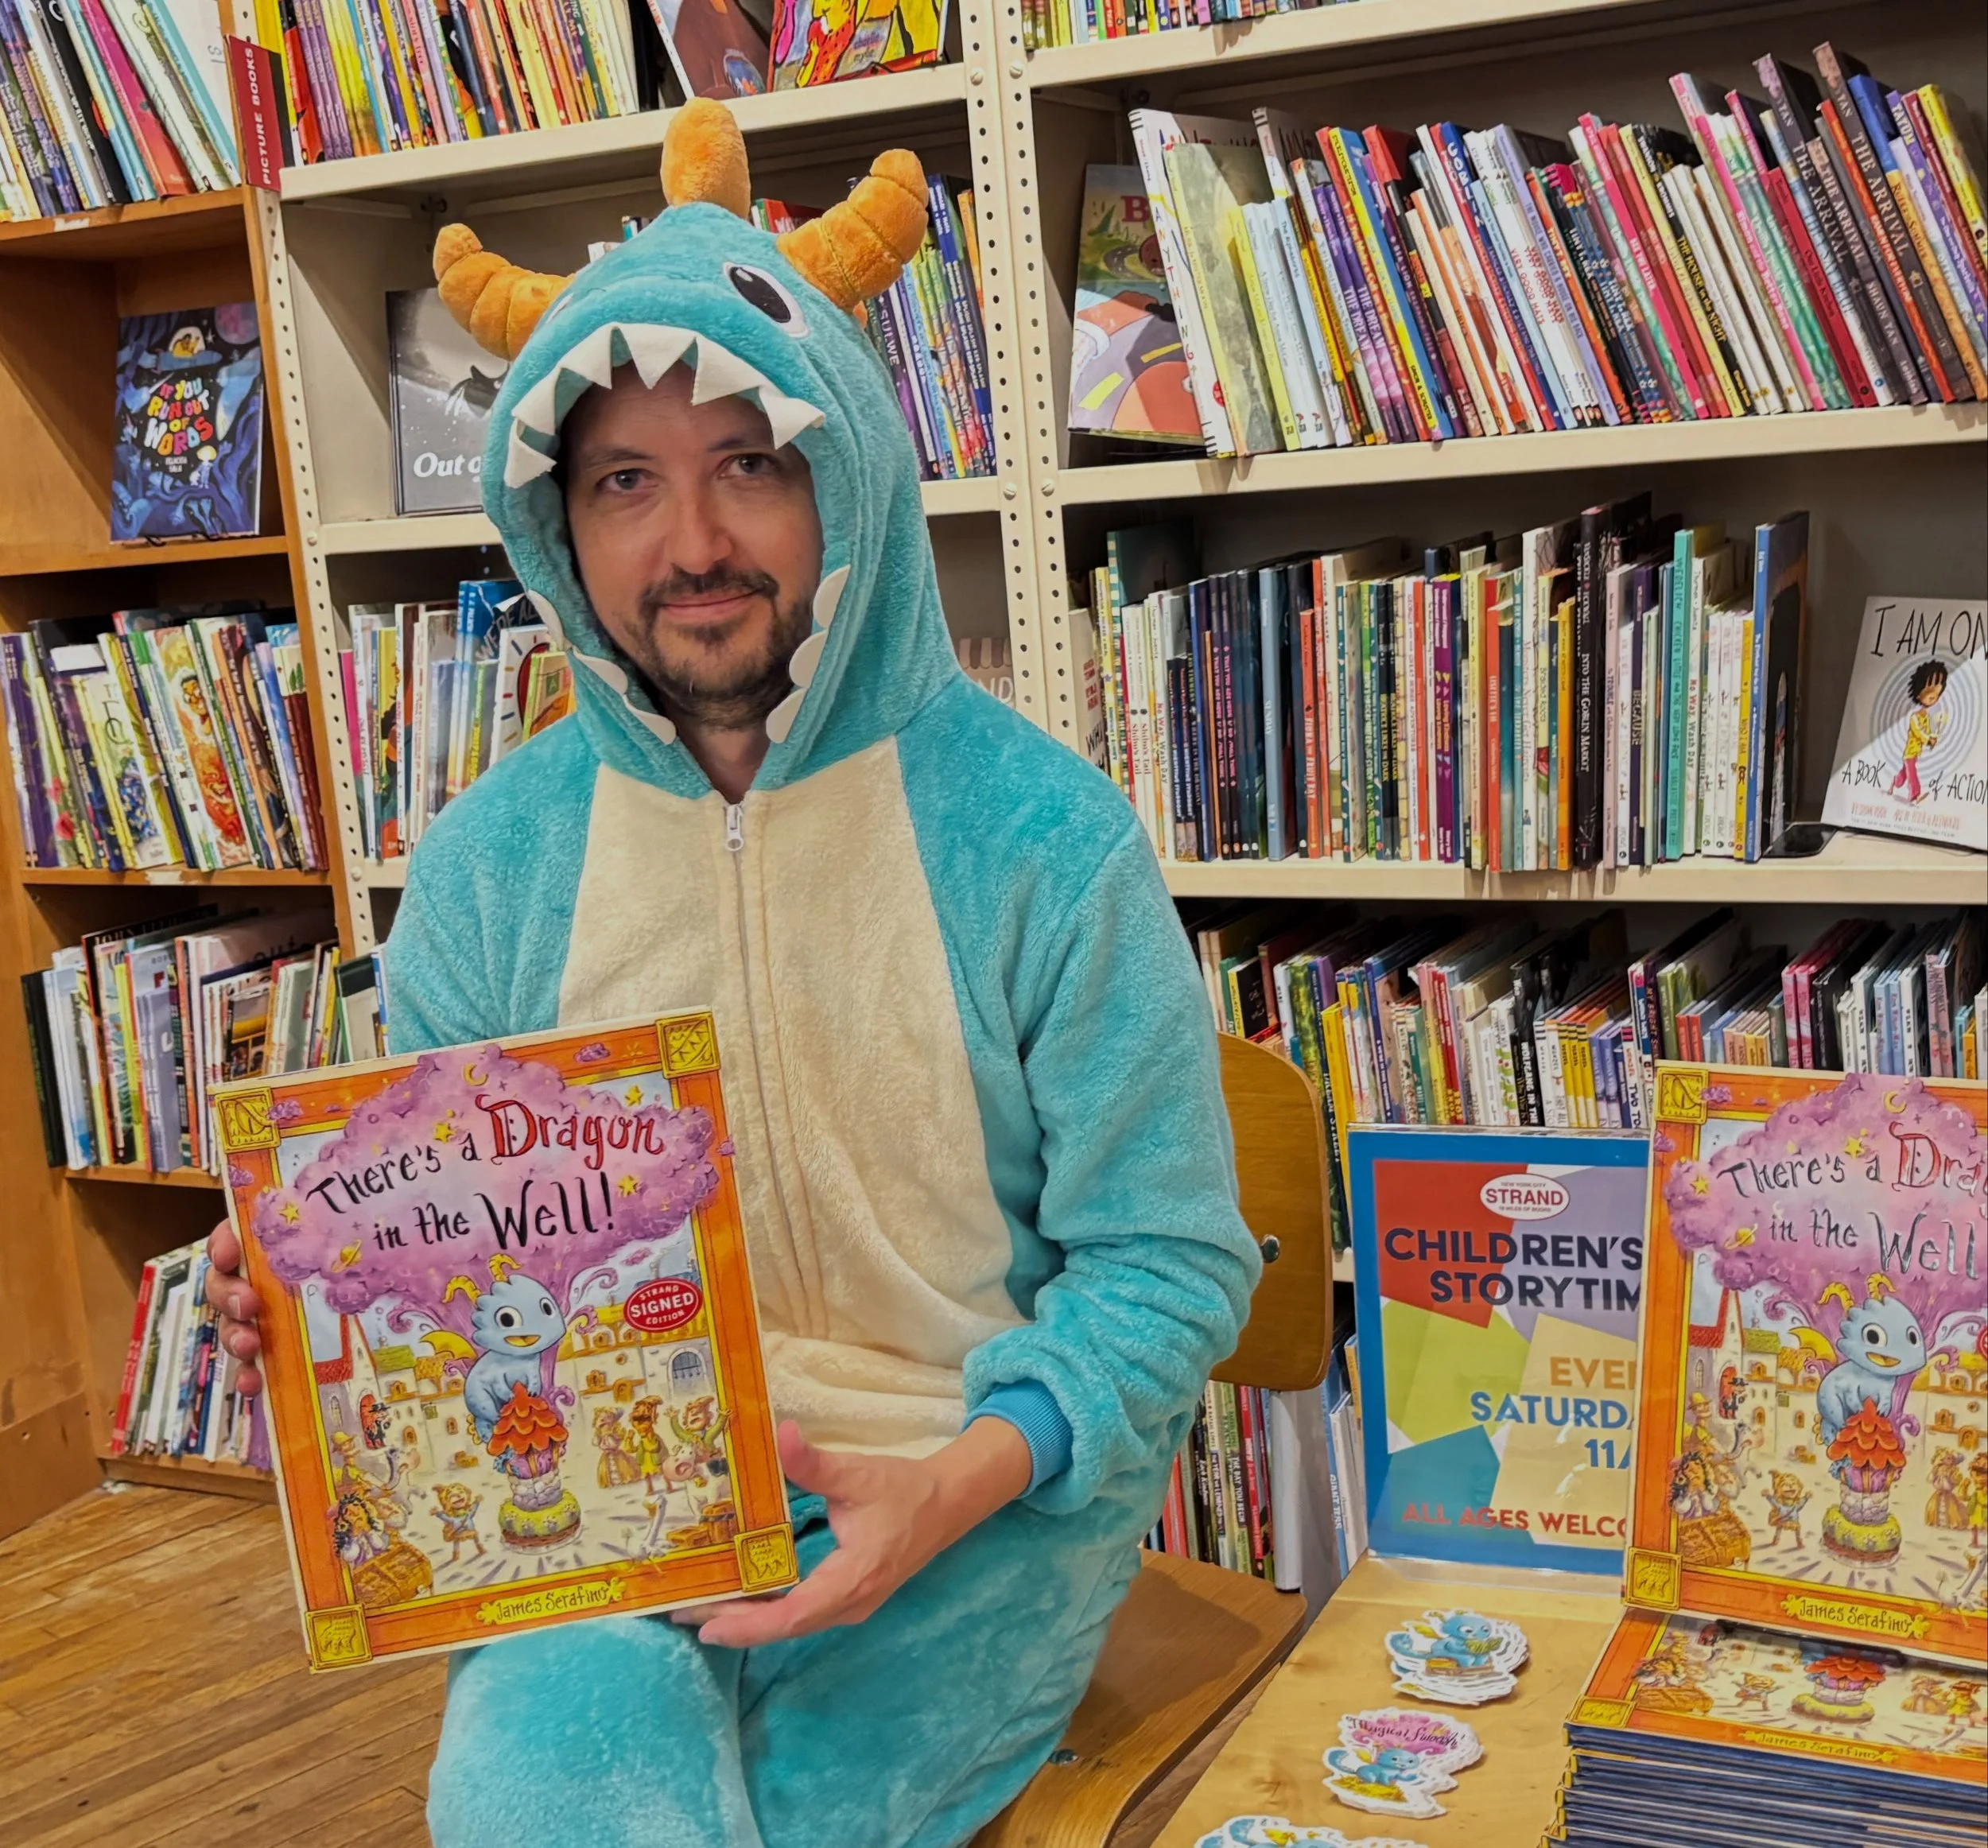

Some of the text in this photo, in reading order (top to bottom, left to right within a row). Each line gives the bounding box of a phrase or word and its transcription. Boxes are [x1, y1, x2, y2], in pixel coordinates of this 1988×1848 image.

[245, 48, 271, 184] PICTURE BOOKS
[1777, 103, 1794, 127] TAN
[1836, 92, 1854, 118] TAN
[1445, 141, 1485, 227] GOBLIN
[1637, 135, 1675, 218] SWANSON KROMMES
[1850, 131, 1911, 257] THE ARRIVAL
[1792, 142, 1848, 263] THE ARRIVAL
[1819, 166, 1866, 262] THE ARRIVAL
[1524, 202, 1535, 214] THE
[1537, 236, 1549, 250] WHO
[1546, 227, 1560, 250] TINY
[1568, 227, 1583, 251] TINY
[1581, 259, 1594, 280] REX
[1735, 210, 1755, 243] Simon
[1760, 270, 1780, 305] Better
[1773, 305, 1790, 330] Bone
[1508, 247, 1545, 325] VERY GOOD HATS
[1599, 280, 1614, 304] TINY
[1612, 313, 1625, 332] REX
[1607, 278, 1622, 301] TINY
[1620, 310, 1633, 330] REX
[1676, 235, 1691, 255] THE
[1684, 254, 1705, 289] HOUSE
[1706, 311, 1726, 343] NIGHT
[1810, 266, 1825, 287] Little
[1818, 286, 1837, 316] Kitchen
[1341, 285, 1372, 351] THE DREAM
[1355, 283, 1386, 348] THE DREAM
[1866, 280, 1900, 346] SHAUN TAN
[147, 390, 210, 420] RUN OUT
[159, 378, 203, 400] IF YOU
[144, 417, 214, 456] WORDS
[169, 417, 190, 433] OF
[414, 452, 481, 483] Out o
[1870, 604, 1897, 658] I
[1897, 608, 1944, 657] AM
[1689, 679, 1697, 691] No
[1155, 703, 1164, 713] No
[1264, 700, 1273, 736] SUNDAY
[1579, 654, 1591, 771] INTO THE GOBLIN MARKET
[1631, 690, 1642, 745] BECAUSE
[1158, 741, 1167, 764] Wash
[1687, 721, 1696, 747] Wash
[1132, 759, 1141, 775] Tail
[1142, 759, 1151, 774] Tail
[1159, 768, 1168, 783] Day
[1842, 760, 1854, 785] A
[1855, 759, 1889, 788] BOOK
[1928, 771, 1944, 802] of
[1520, 1042, 1534, 1090] WOLFGANG
[1527, 1093, 1536, 1104] IN
[1446, 1089, 1456, 1116] BROS
[1452, 1091, 1463, 1120] BROS
[306, 1094, 666, 1214] There's a Dragon
[1717, 1121, 1987, 1219] There's a Dra
[373, 1173, 614, 1250] in the Well!
[1485, 1188, 1563, 1205] STRAND
[1384, 1227, 1643, 1271] CHILDREN'S
[1769, 1209, 1979, 1279] in the Well
[631, 1292, 694, 1318] SIGNED
[639, 1284, 679, 1301] STRAND
[646, 1310, 685, 1325] EDITION
[1231, 1456, 1246, 1522] THE DAY YOU BEGIN
[1402, 1503, 1450, 1526] ALL
[1462, 1506, 1529, 1532] AGES
[497, 1586, 609, 1620] James Serafino
[1800, 1599, 1912, 1633] James Serafino
[1345, 1716, 1408, 1738] Magical
[1758, 1733, 1807, 1749] James
